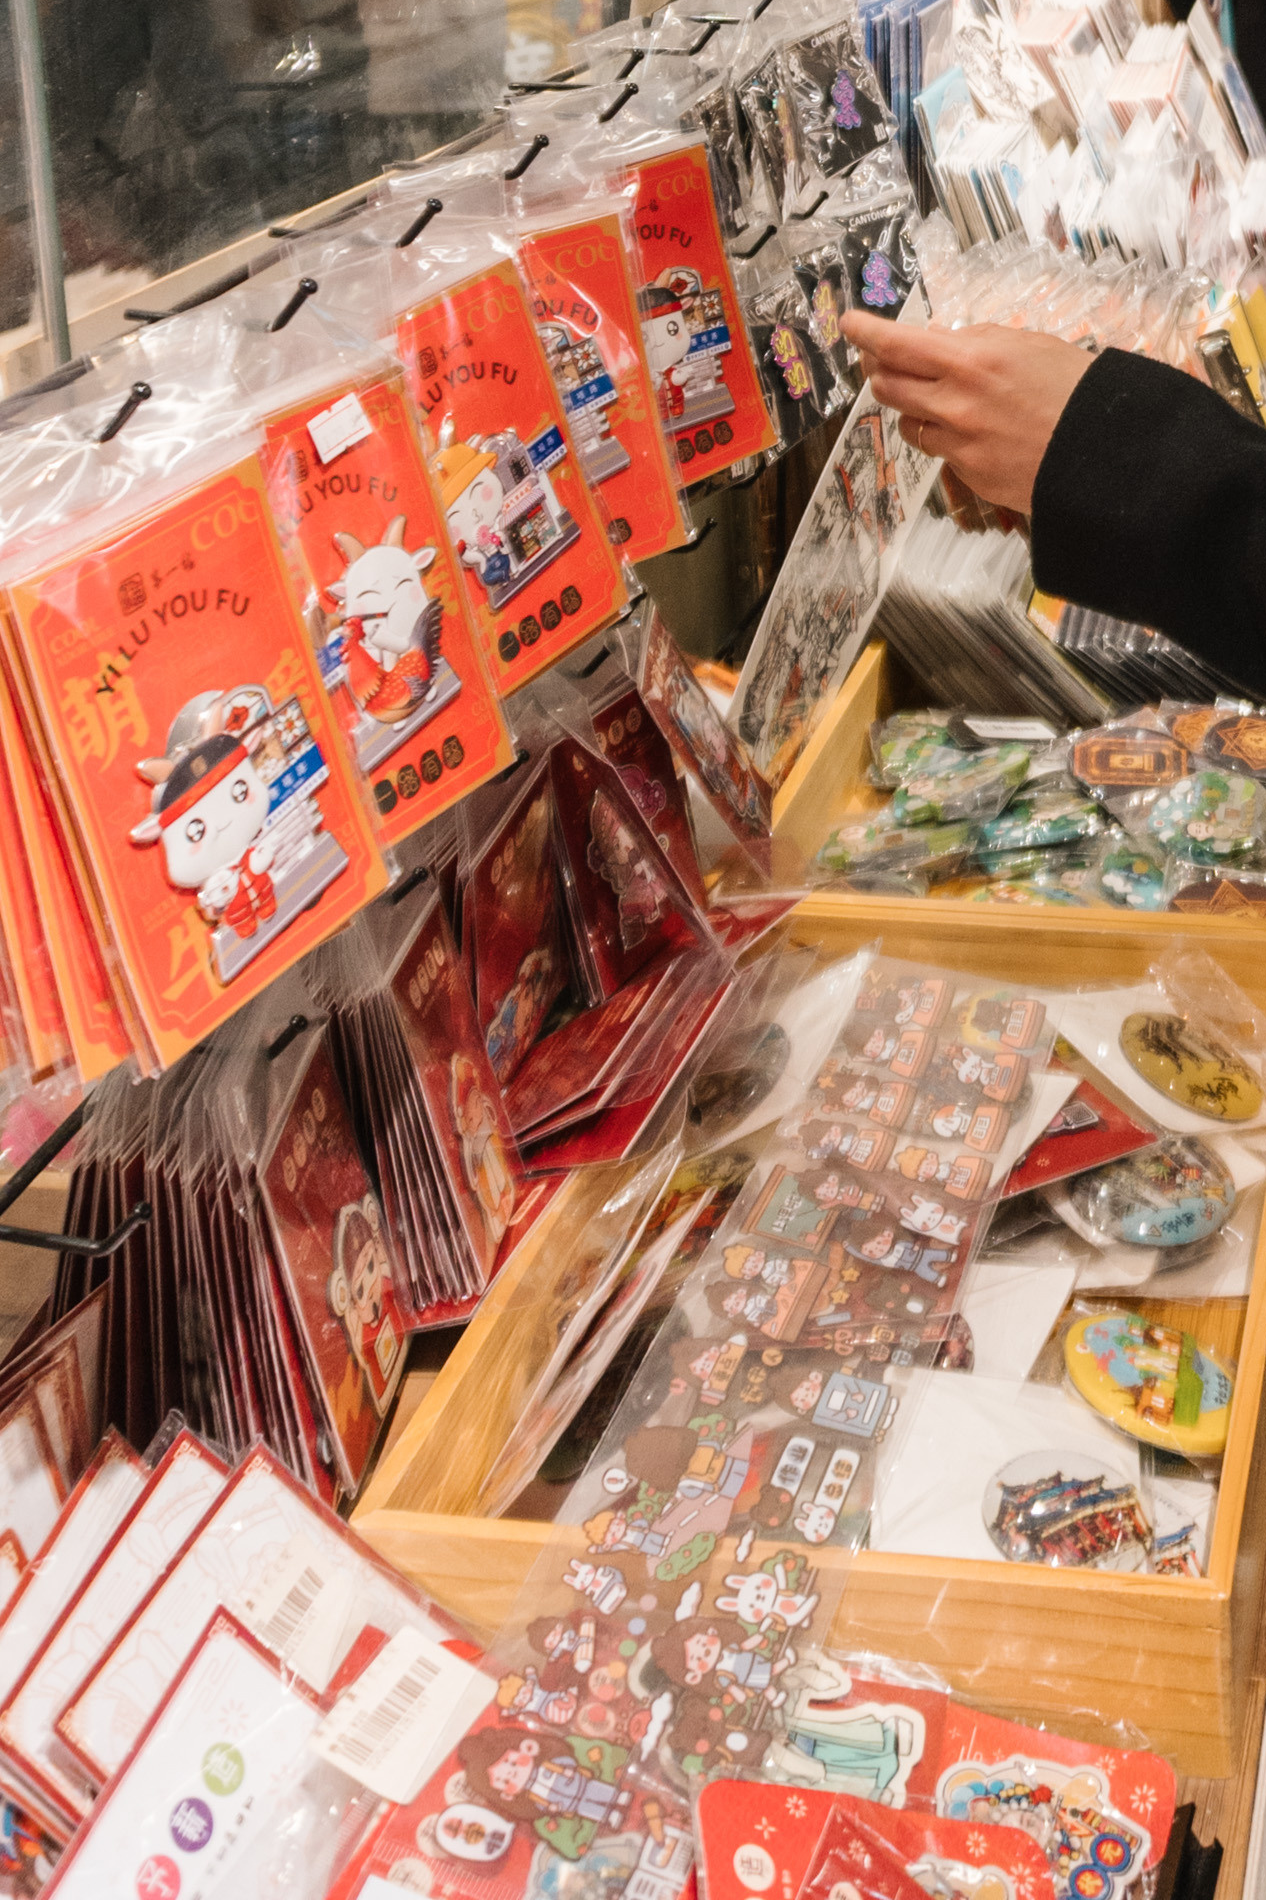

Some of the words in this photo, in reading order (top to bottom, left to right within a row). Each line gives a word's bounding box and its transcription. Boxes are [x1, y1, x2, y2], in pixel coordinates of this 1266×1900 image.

[669, 225, 693, 249] FU
[570, 302, 598, 328] FU
[419, 381, 444, 416] LU
[444, 362, 486, 390] YOU
[490, 362, 519, 386] FU
[314, 473, 361, 505] YOU
[368, 475, 399, 503] FU
[95, 664, 123, 696] YI
[117, 619, 151, 663] LU
[152, 588, 209, 627] YOU
[215, 588, 251, 617] FU
